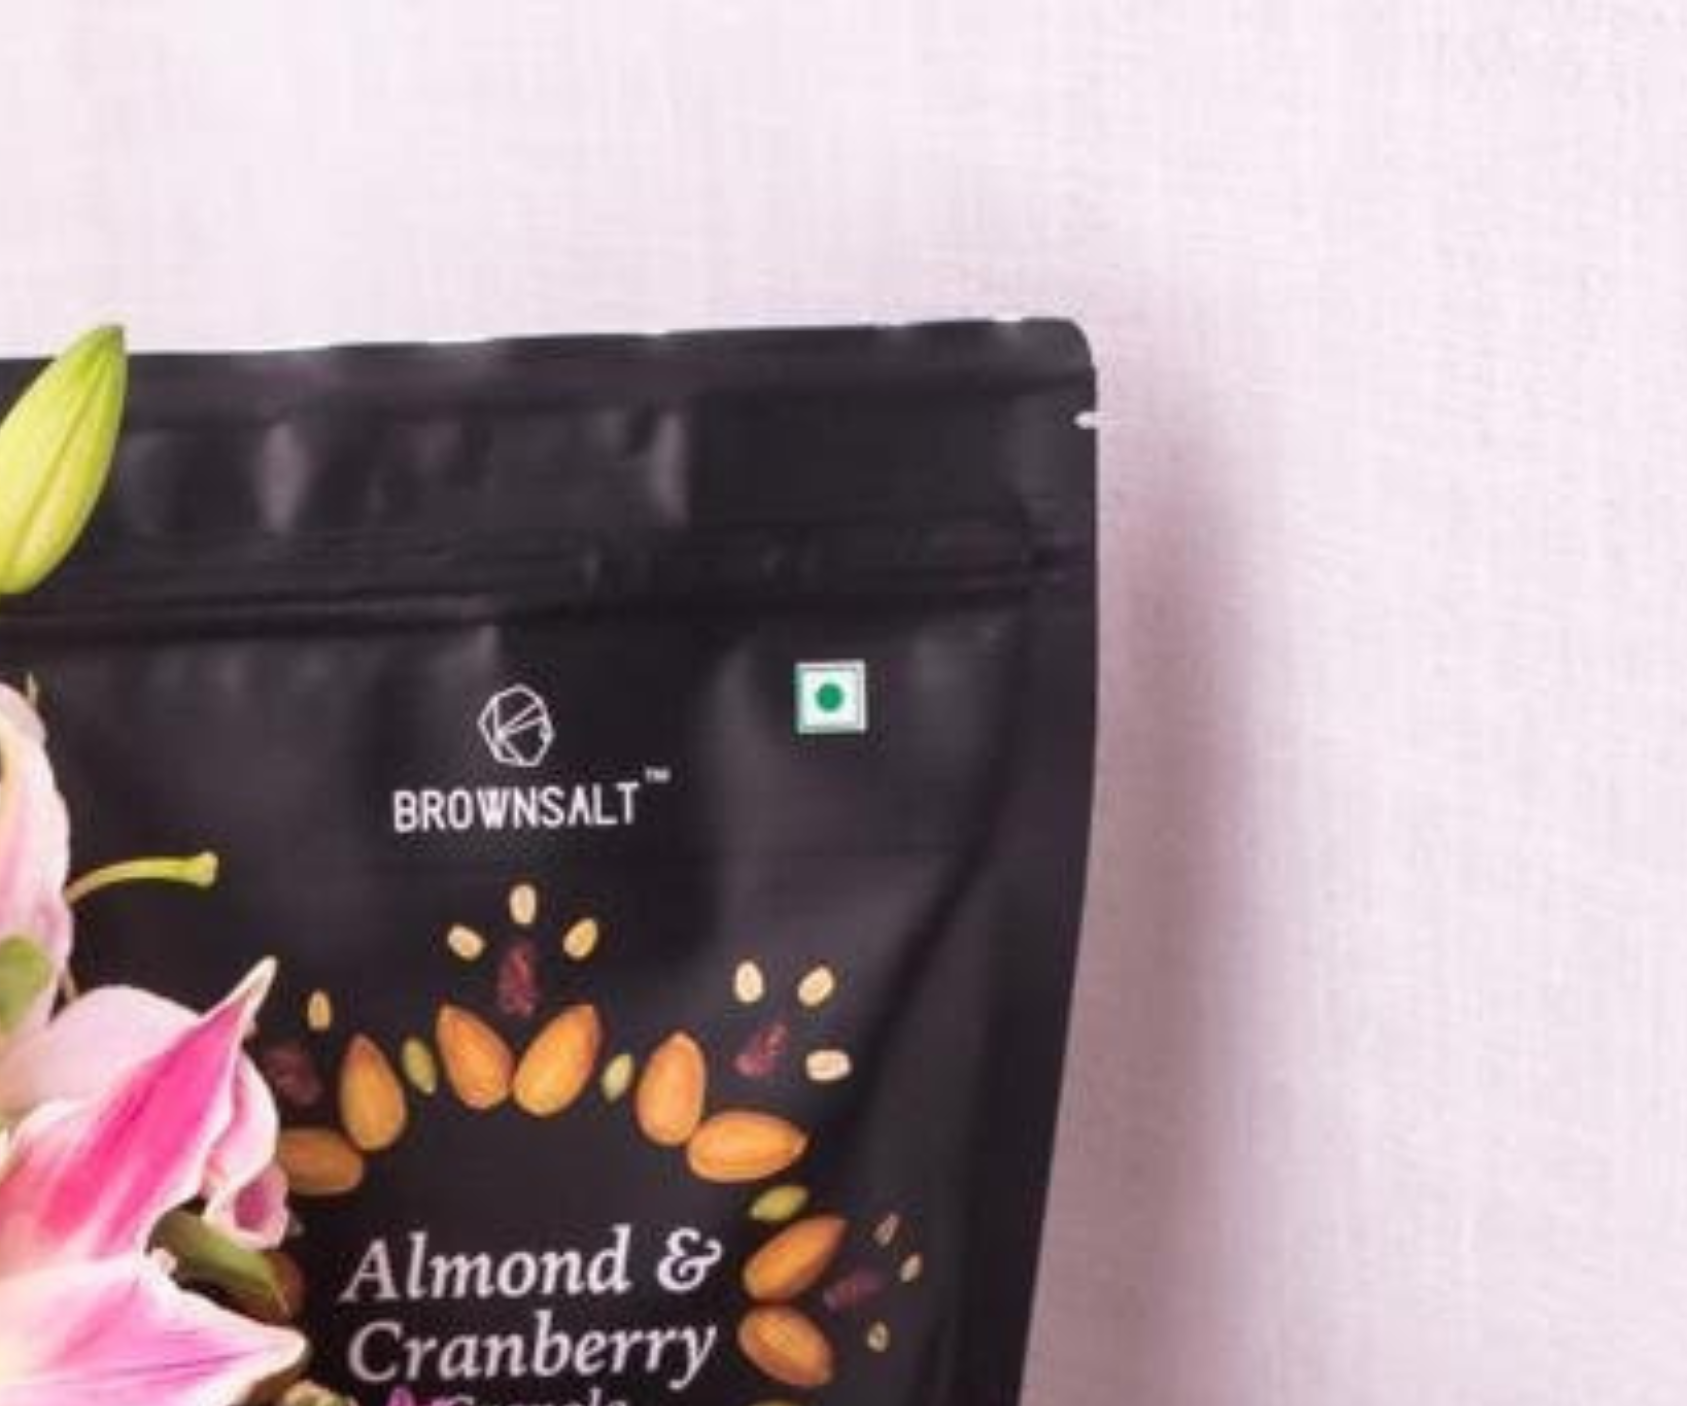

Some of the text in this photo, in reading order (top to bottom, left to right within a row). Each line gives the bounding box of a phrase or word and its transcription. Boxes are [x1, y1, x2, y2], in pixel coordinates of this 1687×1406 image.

[393, 781, 640, 833] BROWNSALT
[339, 1224, 723, 1303] Almond &
[348, 1309, 716, 1391] Cranberry
